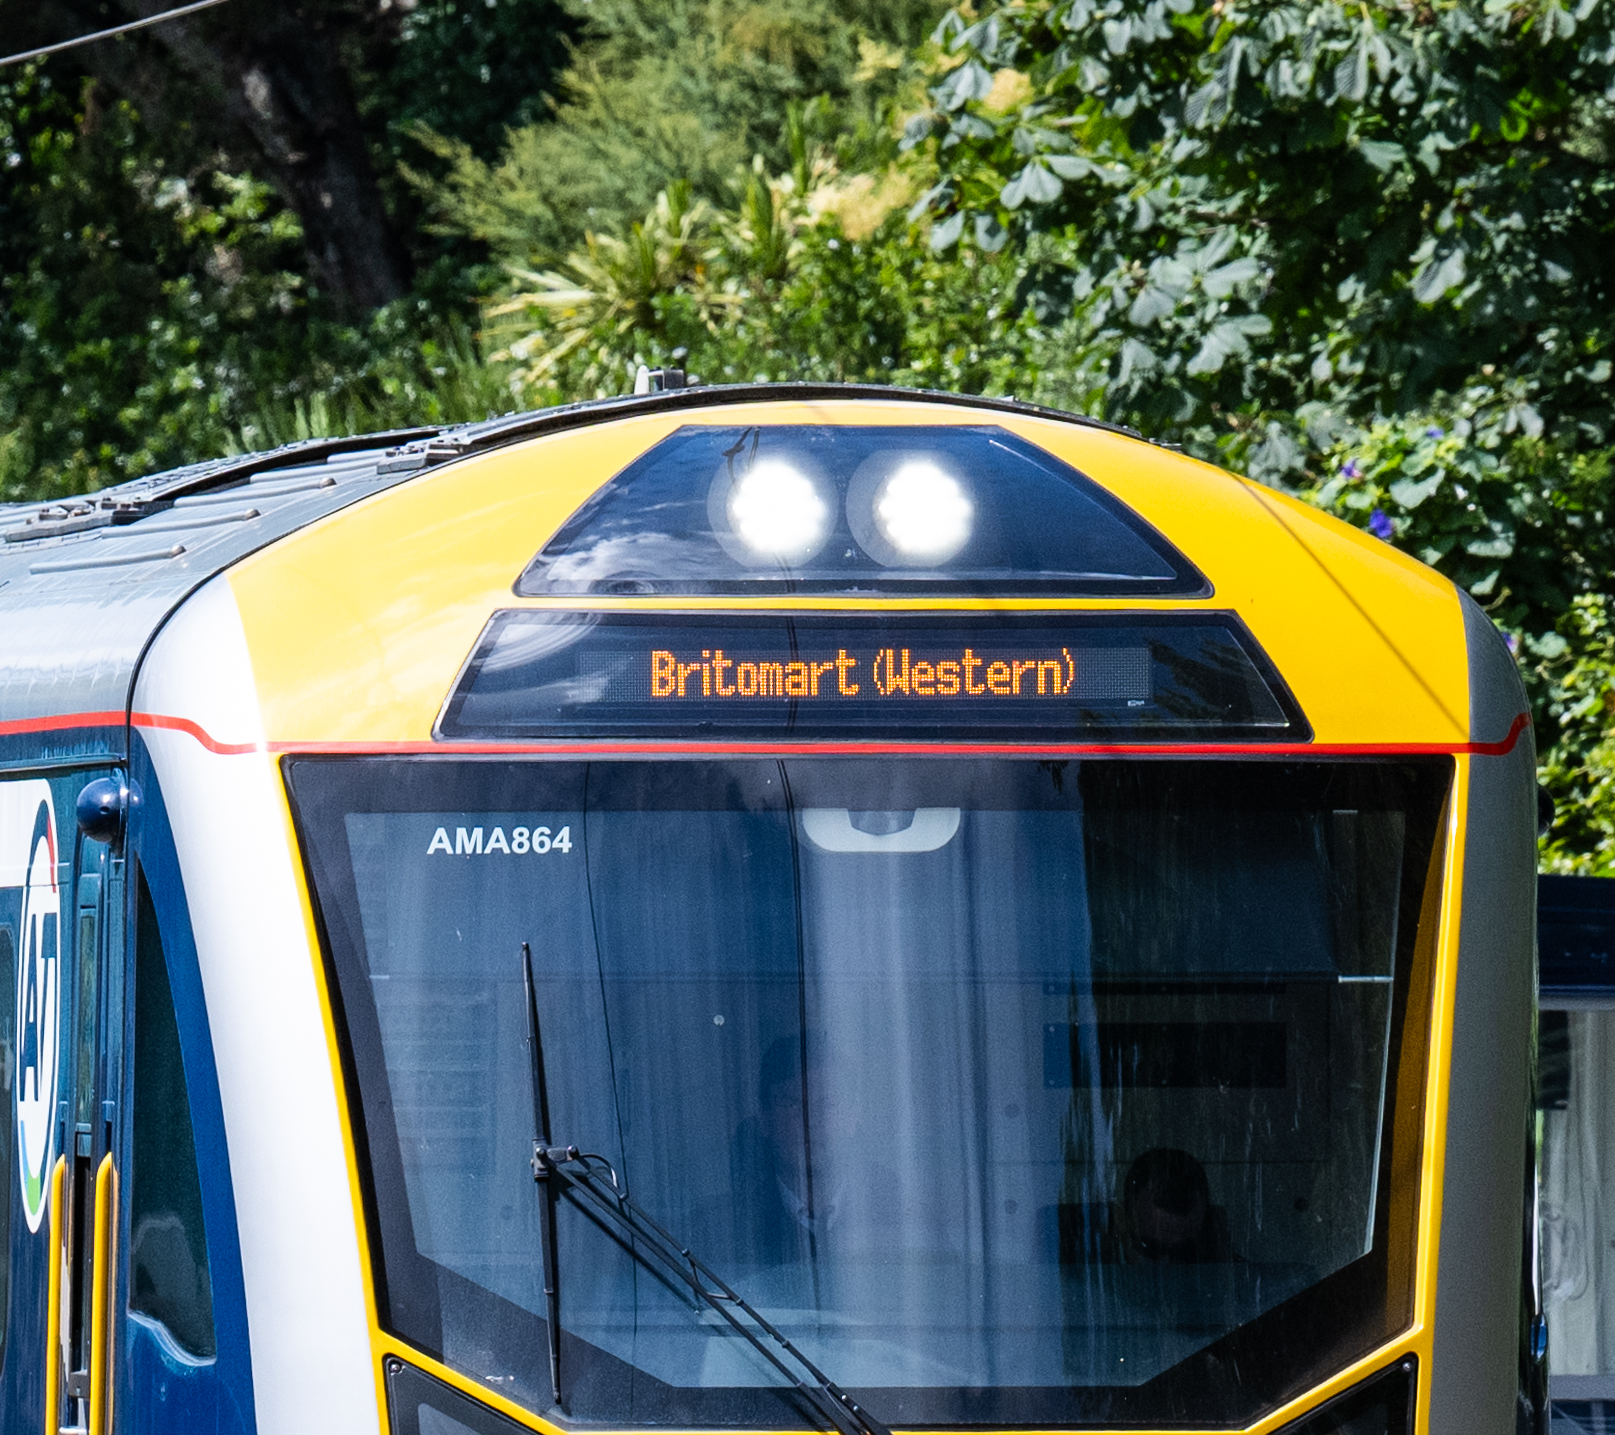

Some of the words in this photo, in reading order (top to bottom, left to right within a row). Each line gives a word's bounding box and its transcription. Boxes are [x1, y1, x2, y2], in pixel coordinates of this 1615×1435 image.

[651, 649, 859, 696] Britomart
[873, 647, 1075, 695] (Western)
[426, 826, 573, 855] AMA864
